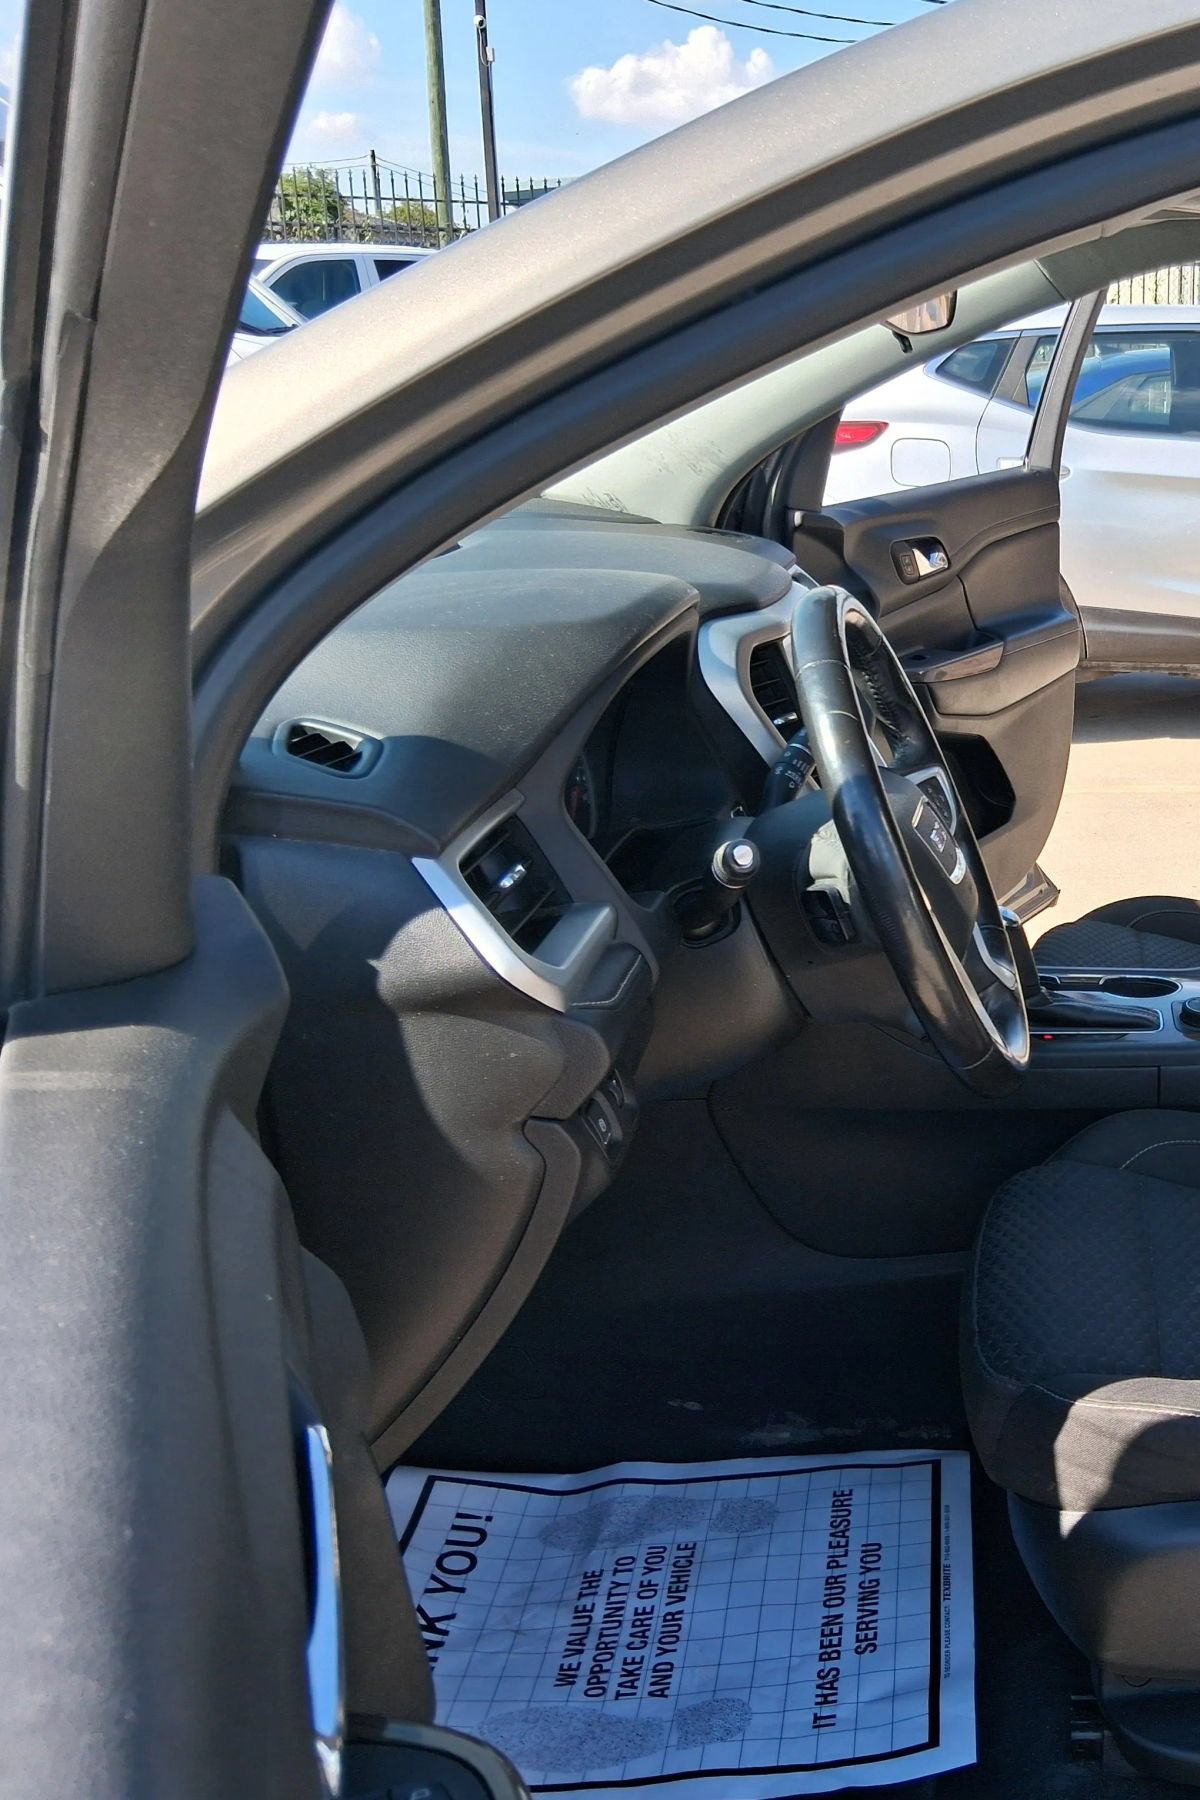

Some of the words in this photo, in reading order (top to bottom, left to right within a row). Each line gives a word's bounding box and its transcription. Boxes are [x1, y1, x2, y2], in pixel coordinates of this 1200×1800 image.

[827, 1489, 853, 1569] PLEASURE
[424, 1513, 493, 1593] YOU!
[642, 1546, 667, 1576] YOU
[859, 1543, 882, 1575] YOU
[578, 1569, 604, 1601] THE
[637, 1580, 658, 1599] OF
[666, 1543, 696, 1606] VEHICLE
[823, 1574, 846, 1608] OUR
[942, 1563, 951, 1601] TEXBRITE
[563, 1603, 595, 1658] VALUE
[584, 1581, 630, 1697] OPPORTUNITY
[613, 1556, 636, 1576] TO
[626, 1605, 654, 1650] CARE
[656, 1610, 684, 1658] YOUR
[855, 1579, 880, 1655] SERVING
[819, 1614, 843, 1662] BEEN
[554, 1662, 581, 1687] WE
[614, 1656, 644, 1700] TAKE
[648, 1662, 674, 1698] AND
[815, 1668, 840, 1705] HAS
[812, 1713, 836, 1728] IT
